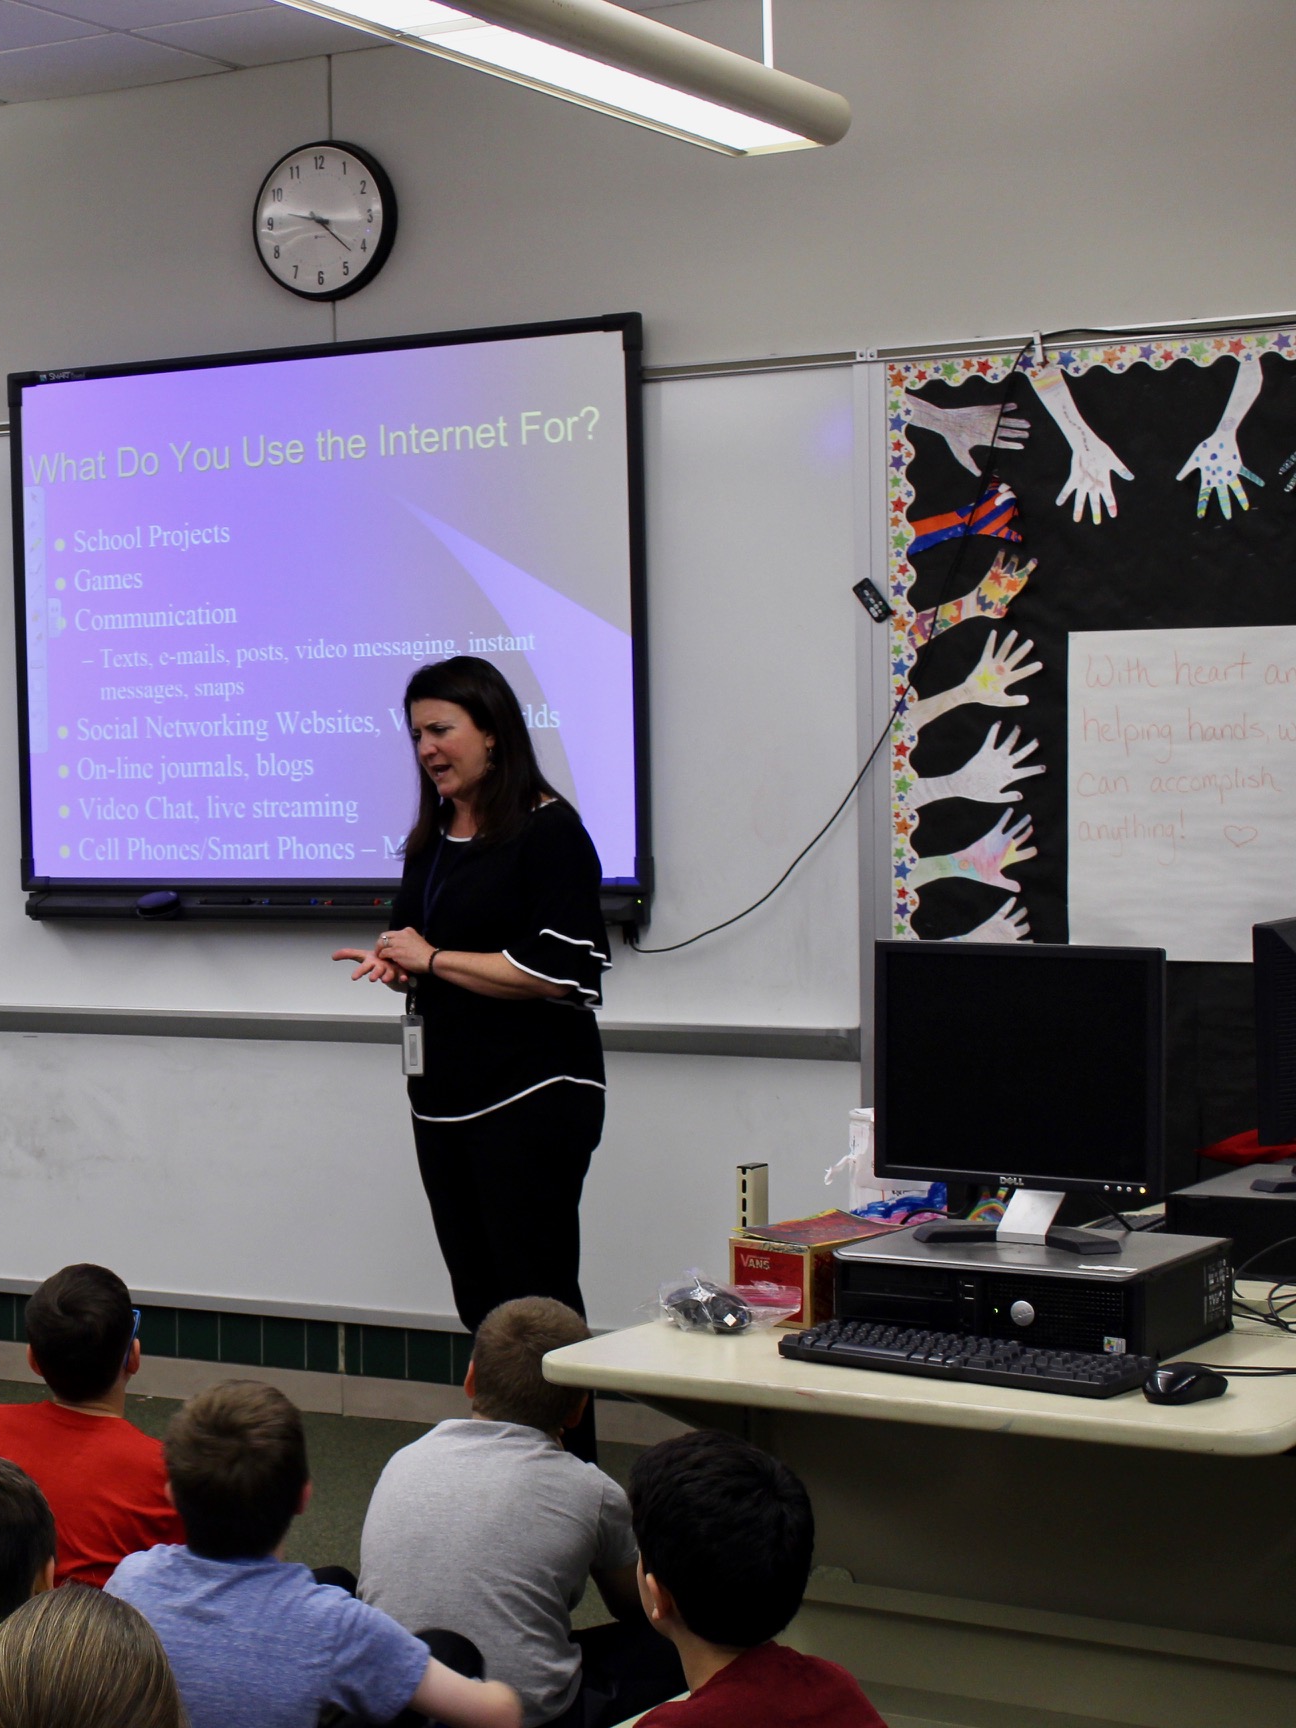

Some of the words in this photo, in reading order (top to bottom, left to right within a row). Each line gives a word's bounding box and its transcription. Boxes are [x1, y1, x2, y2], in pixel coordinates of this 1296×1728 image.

[289, 165, 301, 180] 11
[314, 155, 325, 170] 12
[342, 161, 347, 175] 1
[272, 188, 283, 202] 10
[360, 180, 367, 195] 2
[267, 217, 274, 231] 9
[367, 208, 373, 223] 3
[274, 245, 280, 259] 8
[360, 238, 367, 252] 4
[292, 265, 299, 279] 7
[317, 271, 325, 285] 6
[343, 261, 350, 275] 5
[29, 450, 106, 484] What
[117, 446, 159, 477] Do
[169, 441, 230, 473] You
[243, 435, 304, 467] Use
[316, 429, 366, 461] the
[379, 415, 508, 457] Internet
[520, 406, 600, 445] For?
[73, 526, 142, 552] School
[149, 522, 231, 551] Projects
[74, 568, 143, 592] Games
[75, 602, 238, 632] Communication
[100, 648, 153, 669] Texts,
[159, 643, 231, 666] e-mails,
[236, 644, 289, 668] posts,
[296, 638, 347, 660] video
[353, 633, 462, 662] messaging,
[469, 631, 536, 653] instant
[1085, 654, 1159, 688] With
[1174, 650, 1253, 688] heart
[1264, 663, 1296, 685] an
[100, 682, 188, 704] messages,
[194, 679, 245, 702] snaps
[77, 716, 139, 741] Social
[145, 713, 269, 741] Networking
[275, 708, 381, 737] Websites,
[1082, 705, 1173, 764] helping
[1278, 721, 1296, 742] w
[77, 756, 154, 780] On-line
[157, 754, 250, 785] journals,
[256, 753, 315, 782] blogs
[1149, 766, 1282, 804] accomplish
[79, 796, 139, 820] Video
[145, 796, 200, 824] Chat,
[207, 795, 246, 819] live
[252, 793, 359, 823] streaming
[1077, 808, 1186, 867] anything!
[78, 837, 120, 861] Cell
[127, 836, 271, 861] Phones/Smart
[277, 836, 356, 861] Phones
[999, 1176, 1024, 1186] DELL
[740, 1252, 771, 1271] VANS
